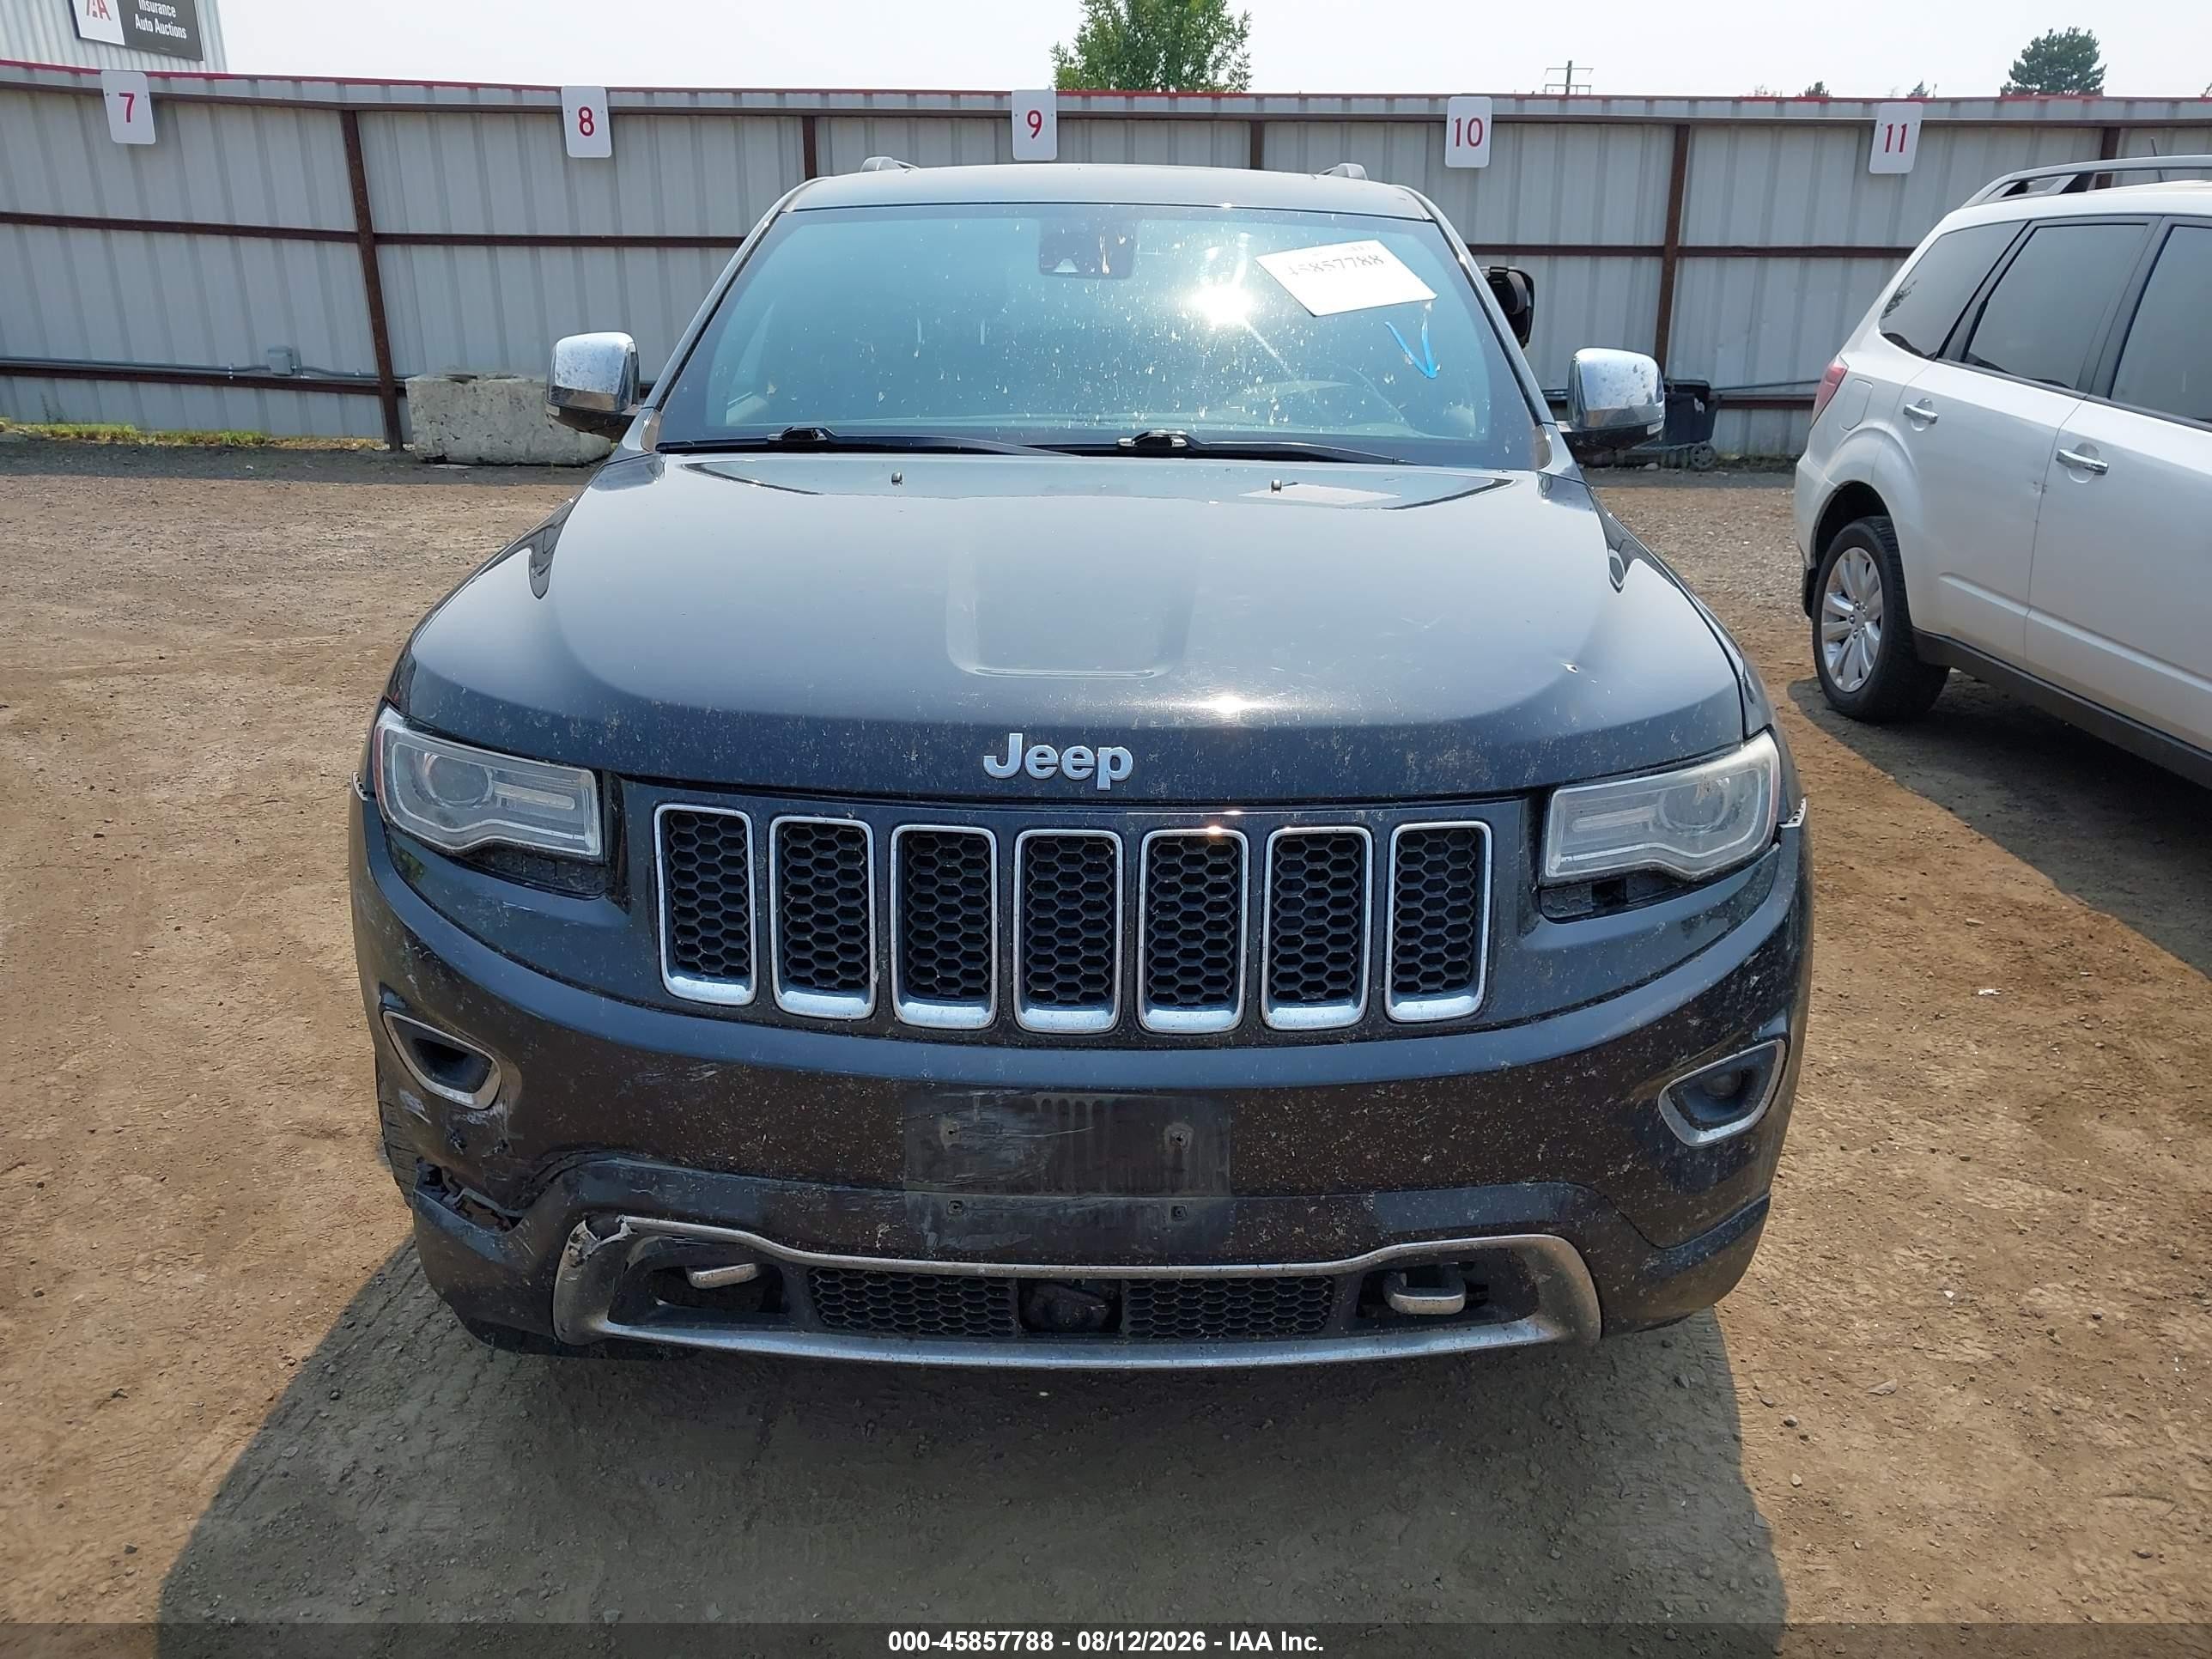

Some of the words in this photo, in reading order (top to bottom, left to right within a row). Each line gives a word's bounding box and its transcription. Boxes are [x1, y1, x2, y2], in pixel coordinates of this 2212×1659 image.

[135, 13, 154, 33] Auto
[155, 17, 187, 39] Auctions
[118, 92, 135, 123] 7
[578, 106, 594, 137] 8
[1027, 110, 1042, 139] 9
[1455, 117, 1483, 148] 10
[1885, 123, 1908, 153] 11
[983, 732, 1133, 791] Jeep
